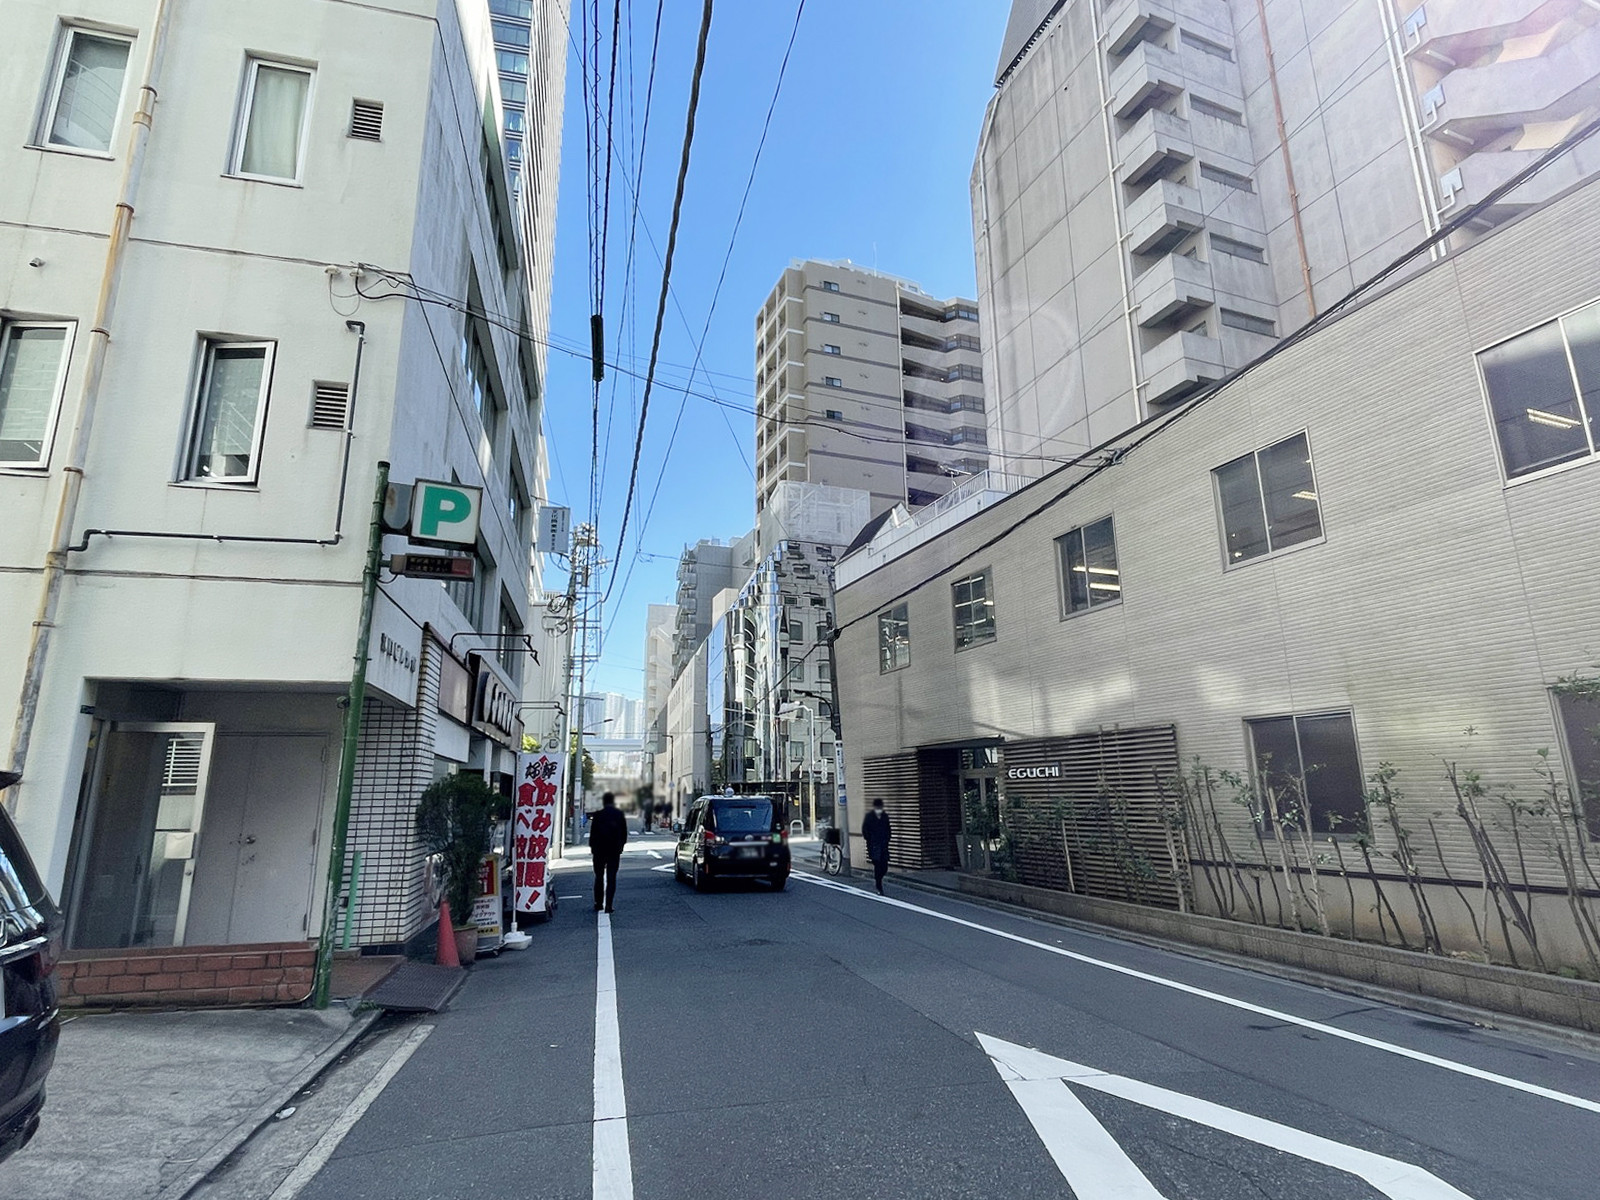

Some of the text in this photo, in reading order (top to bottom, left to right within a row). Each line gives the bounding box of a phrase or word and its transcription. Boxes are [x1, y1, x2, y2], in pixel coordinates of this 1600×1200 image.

[420, 486, 472, 537] P
[525, 761, 558, 780] 好評
[1008, 766, 1059, 779] EGUCHI
